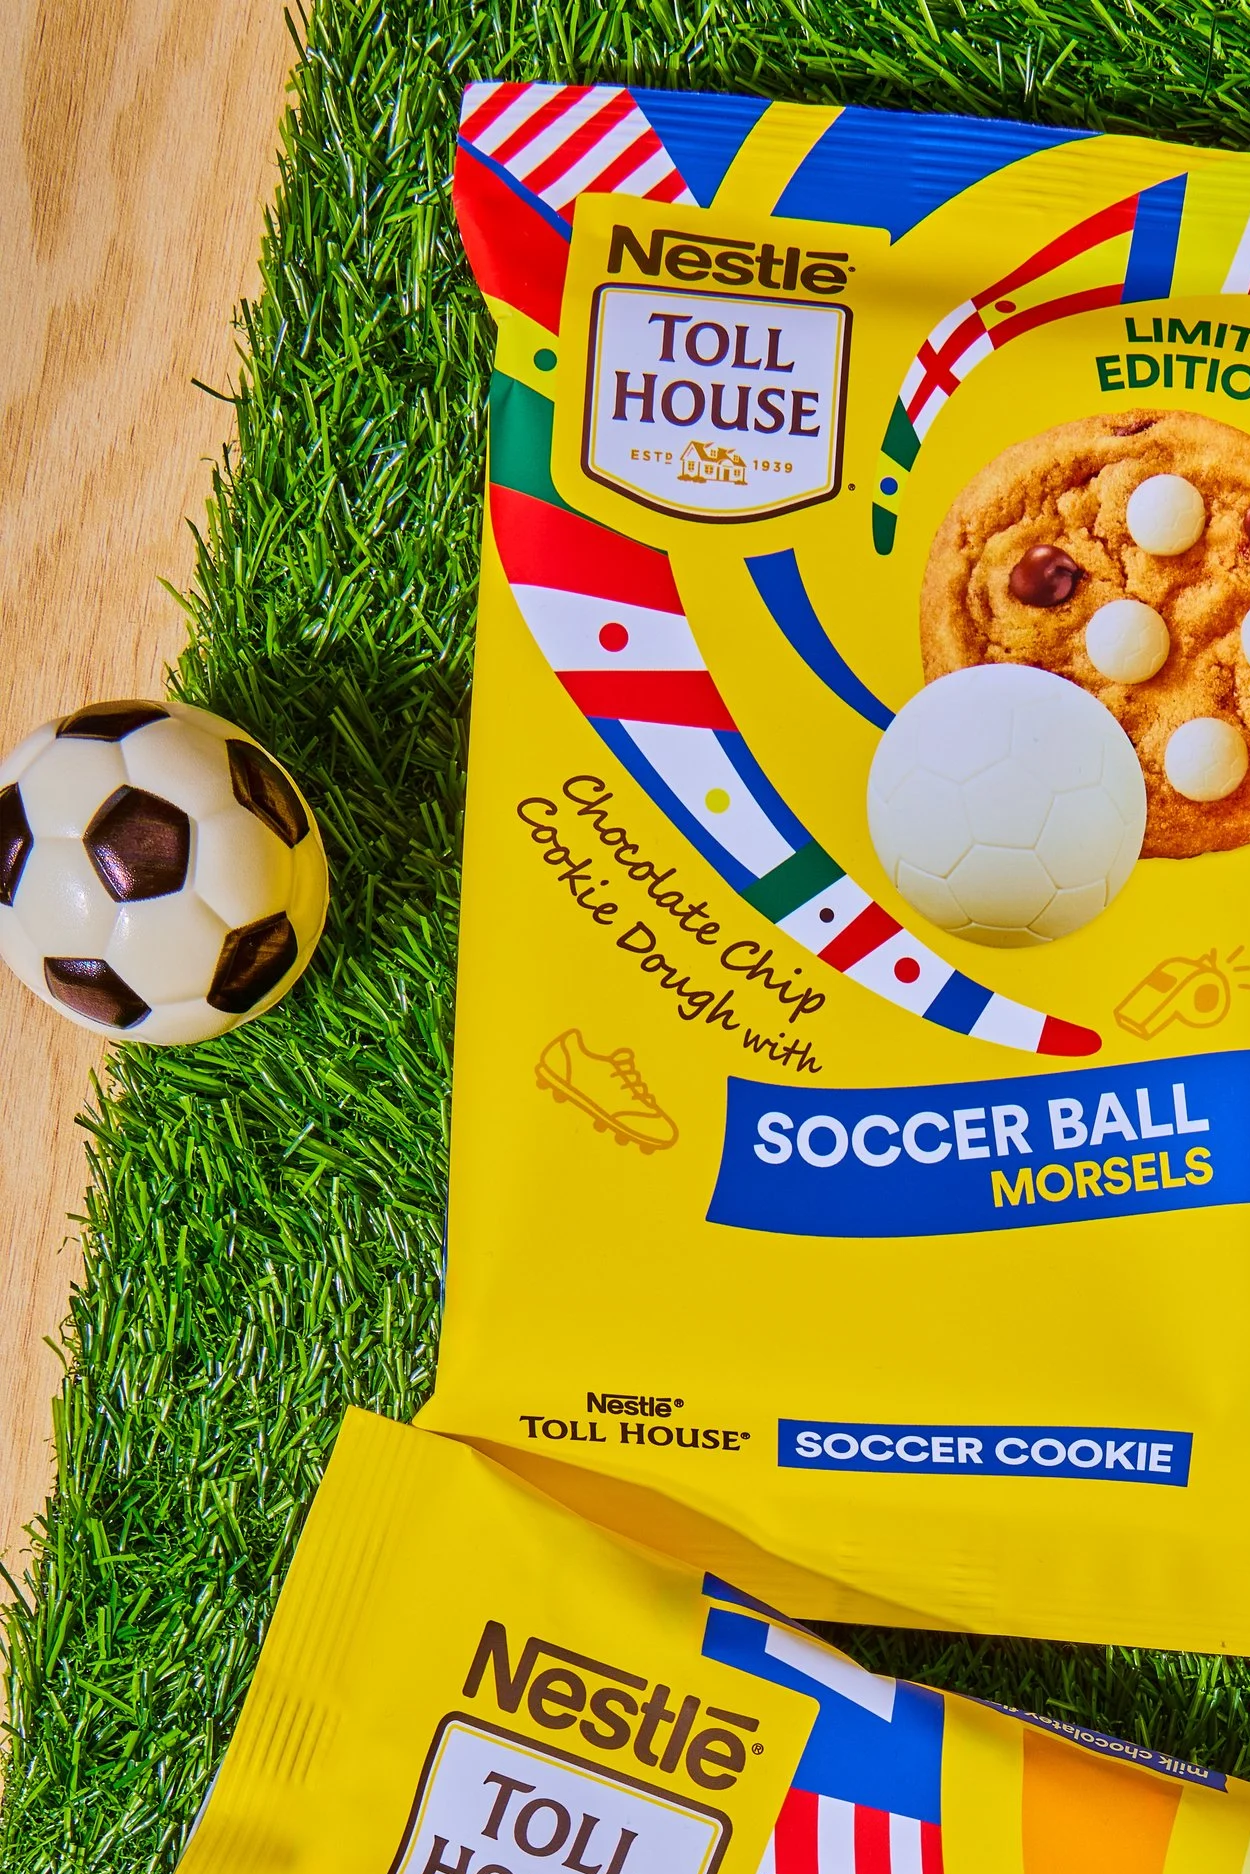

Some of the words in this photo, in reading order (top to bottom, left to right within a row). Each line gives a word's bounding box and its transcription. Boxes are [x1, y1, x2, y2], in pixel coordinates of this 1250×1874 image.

[648, 313, 796, 373] TOLL
[612, 370, 821, 437] HOUSE
[753, 459, 793, 473] 1939
[563, 775, 720, 945] Chocolate
[720, 940, 826, 1023] Chip
[517, 797, 618, 925] Cookie
[616, 921, 740, 1031] Dough
[743, 1028, 822, 1073] with
[753, 1104, 1033, 1167] SOCCER
[1048, 1083, 1210, 1151] BALL
[990, 1147, 1213, 1208] MORSELS
[519, 1415, 607, 1442] TOLL
[795, 1430, 983, 1464] SOCCER
[995, 1437, 1174, 1473] COOKIE
[1158, 1754, 1209, 1779] milk
